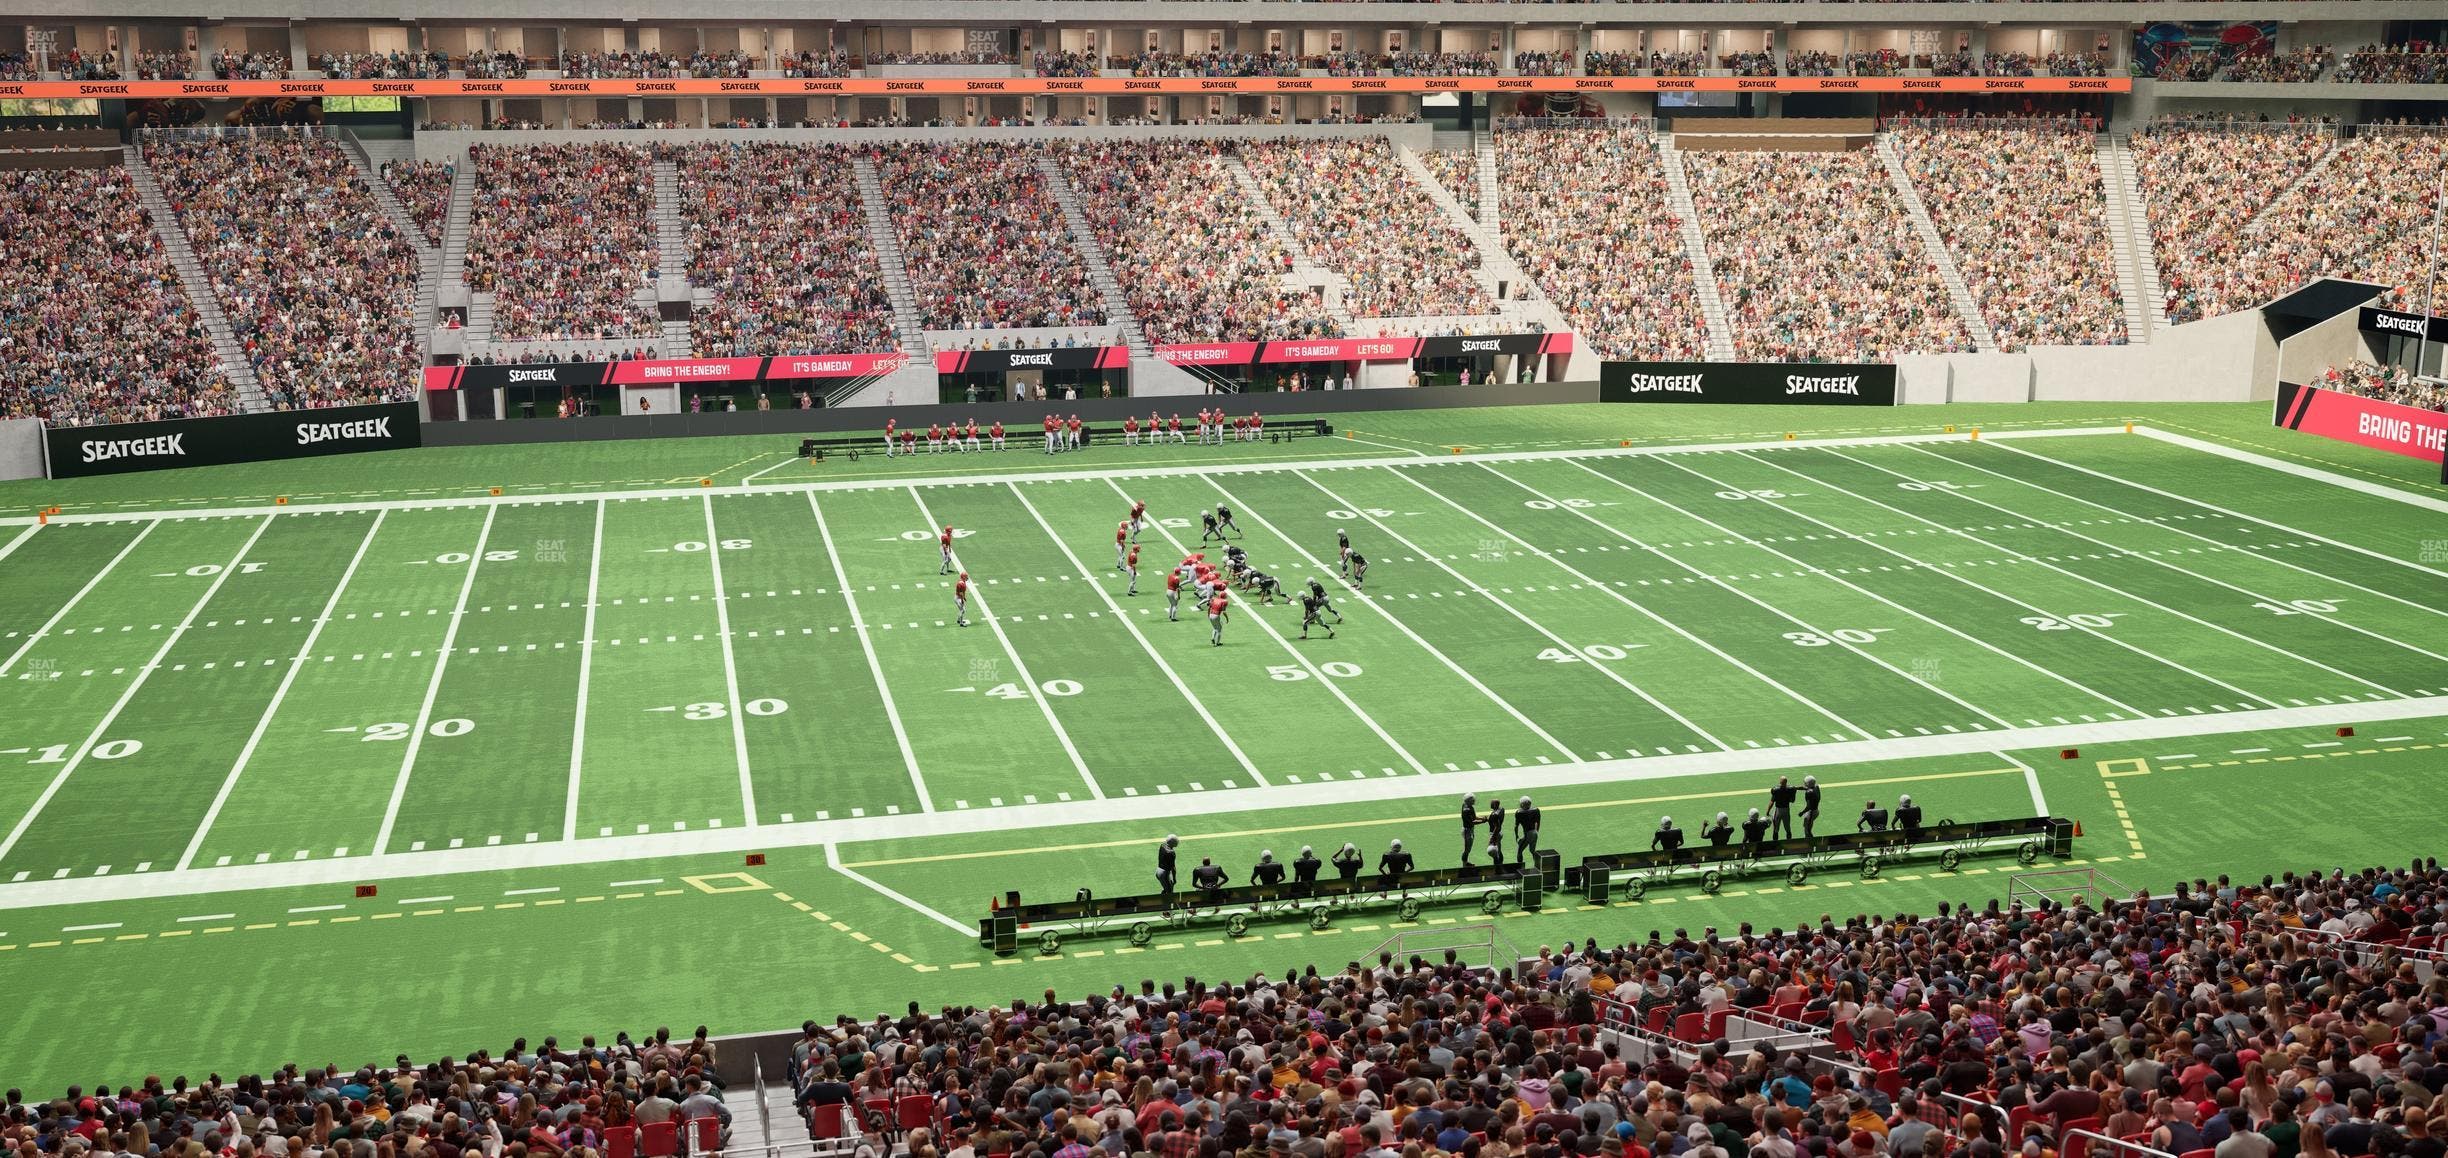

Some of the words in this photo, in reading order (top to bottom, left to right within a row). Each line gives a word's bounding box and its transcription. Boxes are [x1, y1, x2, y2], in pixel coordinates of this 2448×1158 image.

[280, 83, 325, 93] SEATGEEK
[372, 83, 415, 93] SEATGEEK
[461, 83, 504, 92] SEATGEEK
[549, 82, 591, 92] SEATGEEK
[635, 82, 677, 92] SEATGEEK
[720, 82, 761, 91] SEATGEEK
[804, 82, 843, 91] SEATGEEK
[886, 81, 925, 91] SEATGEEK
[967, 81, 1005, 90] SEATGEEK
[1046, 81, 1084, 90] SEATGEEK
[1124, 81, 1161, 90] SEATGEEK
[1201, 80, 1238, 89] SEATGEEK
[1277, 80, 1313, 89] SEATGEEK
[1351, 80, 1387, 89] SEATGEEK
[1424, 80, 1460, 89] SEATGEEK
[1497, 79, 1533, 88] SEATGEEK
[1575, 79, 1614, 88] SEATGEEK
[1656, 80, 1695, 89] SEATGEEK
[1738, 80, 1777, 89] SEATGEEK
[1819, 80, 1859, 89] SEATGEEK
[1902, 80, 1942, 89] SEATGEEK
[1985, 80, 2025, 89] SEATGEEK
[2068, 80, 2108, 89] SEATGEEK
[79, 84, 129, 95] SEATGEEK
[182, 84, 229, 94] SEATGEEK
[2376, 313, 2425, 335] SEATGEEK
[1357, 344, 1379, 355] LET'S
[1380, 343, 1394, 354] GO!
[1461, 338, 1501, 353] SEATGEEK
[1177, 350, 1193, 361] THE
[1193, 348, 1228, 360] ENERGY!
[1285, 346, 1300, 357] IT'S
[1301, 345, 1339, 357] GAMEDAY
[1009, 352, 1054, 367] SEATGEEK
[644, 366, 673, 378] BRING
[674, 365, 692, 377] THE
[692, 364, 731, 376] ENERGY!
[793, 361, 809, 373] IT'S
[811, 360, 853, 372] GAMEDAY
[508, 367, 557, 383] SEATGEEK
[1630, 373, 1704, 394] SEATGEEK
[1785, 374, 1860, 396] SEATGEEK
[296, 416, 392, 445] SEATGEEK
[2358, 412, 2411, 443] BRING
[2416, 424, 2447, 452] THE
[81, 432, 186, 463] SEATGEEK
[2251, 599, 2339, 616] 10
[2019, 614, 2114, 631] 20
[1782, 629, 1877, 647] 30
[1536, 644, 1628, 663] 40
[1265, 661, 1363, 681] 50
[985, 679, 1084, 700] 40
[684, 698, 789, 721] 30
[361, 718, 475, 742] 20
[27, 739, 143, 764] 10
[361, 887, 371, 897] 20
